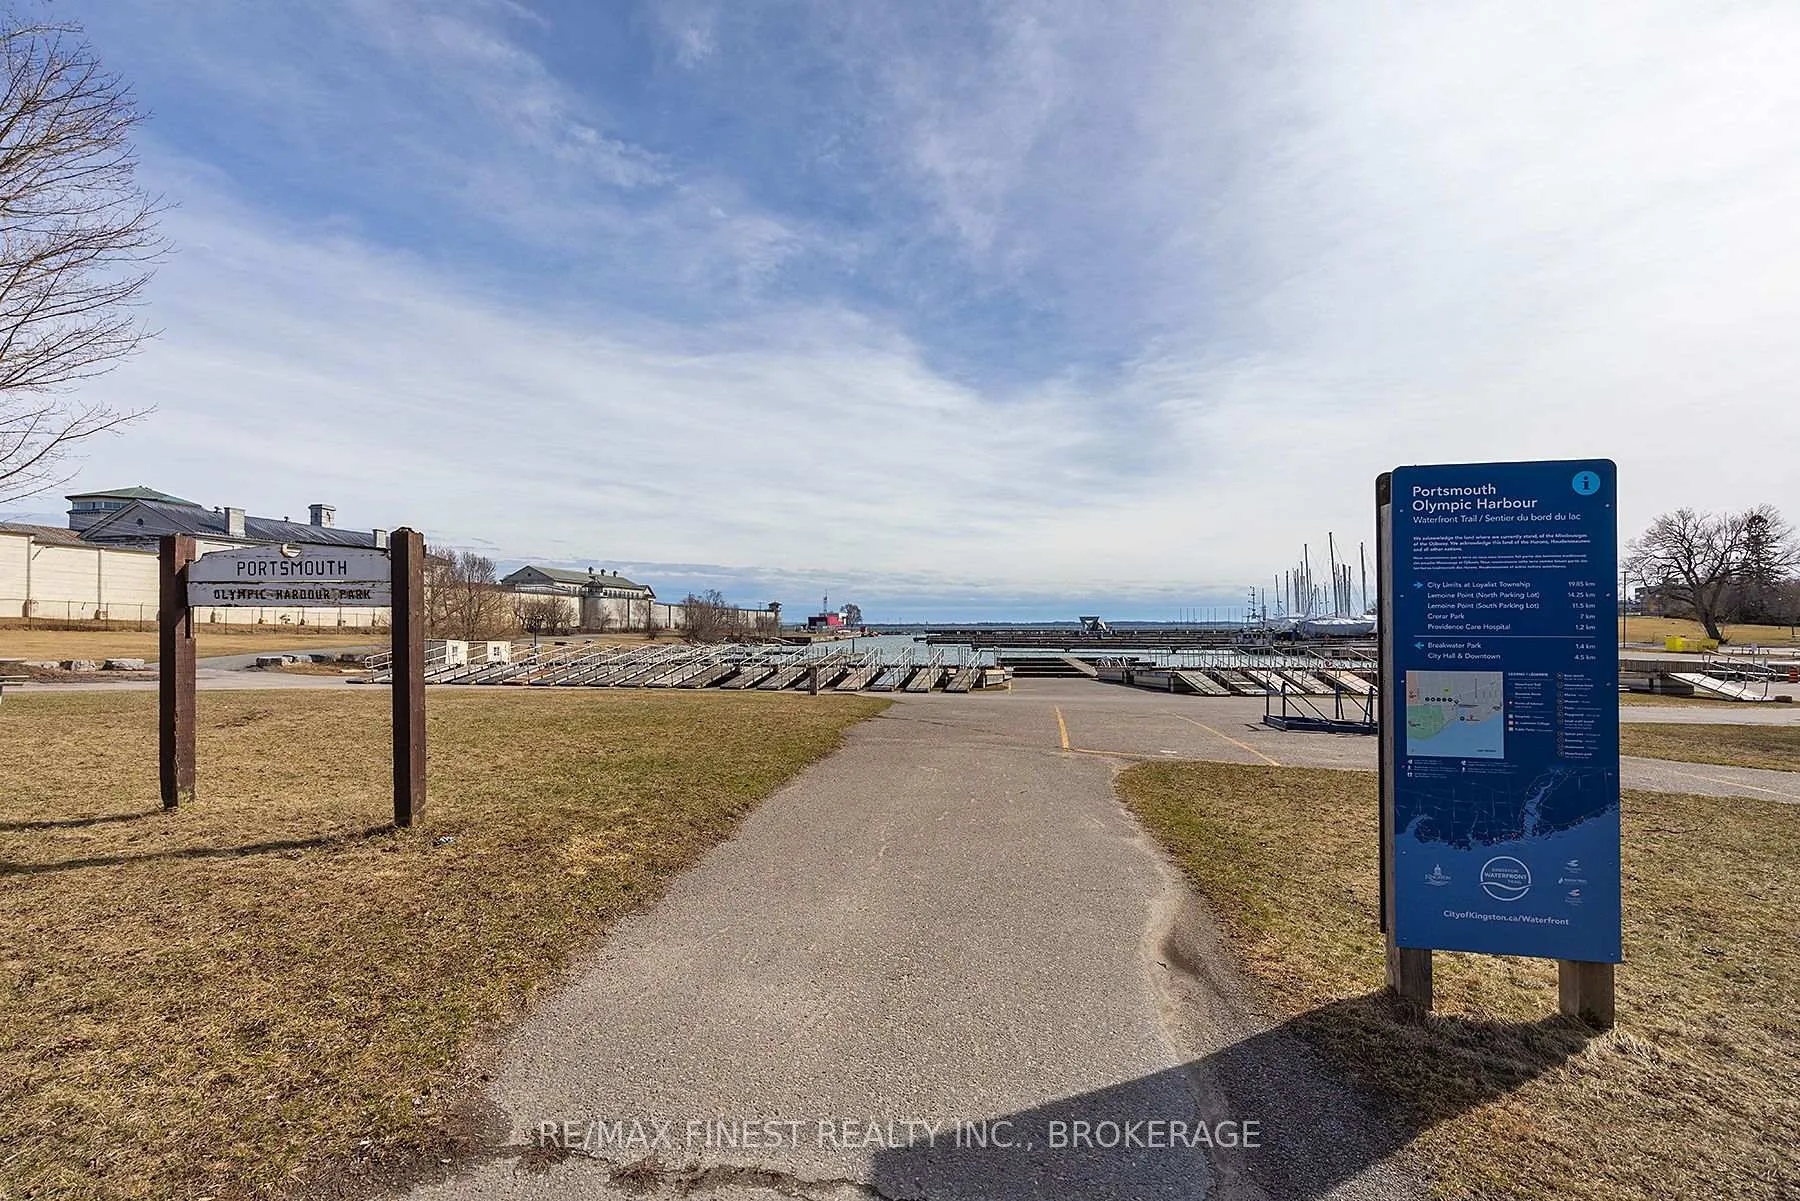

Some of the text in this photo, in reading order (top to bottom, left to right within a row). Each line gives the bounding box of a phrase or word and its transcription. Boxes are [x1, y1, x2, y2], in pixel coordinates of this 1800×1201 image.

[1412, 484, 1496, 497] Portsmouth
[1412, 498, 1538, 513] Olympic Harbour
[1413, 516, 1458, 524] Waterfront
[1461, 514, 1477, 523] Trail
[1485, 514, 1514, 522] Sentier
[237, 560, 347, 576] PORTSMOUTH
[214, 589, 266, 600] OLYMPIC
[340, 589, 372, 600] PARK
[1483, 624, 1511, 632] Hospital
[1443, 910, 1569, 926] CityofKingston.ca/Waterfront
